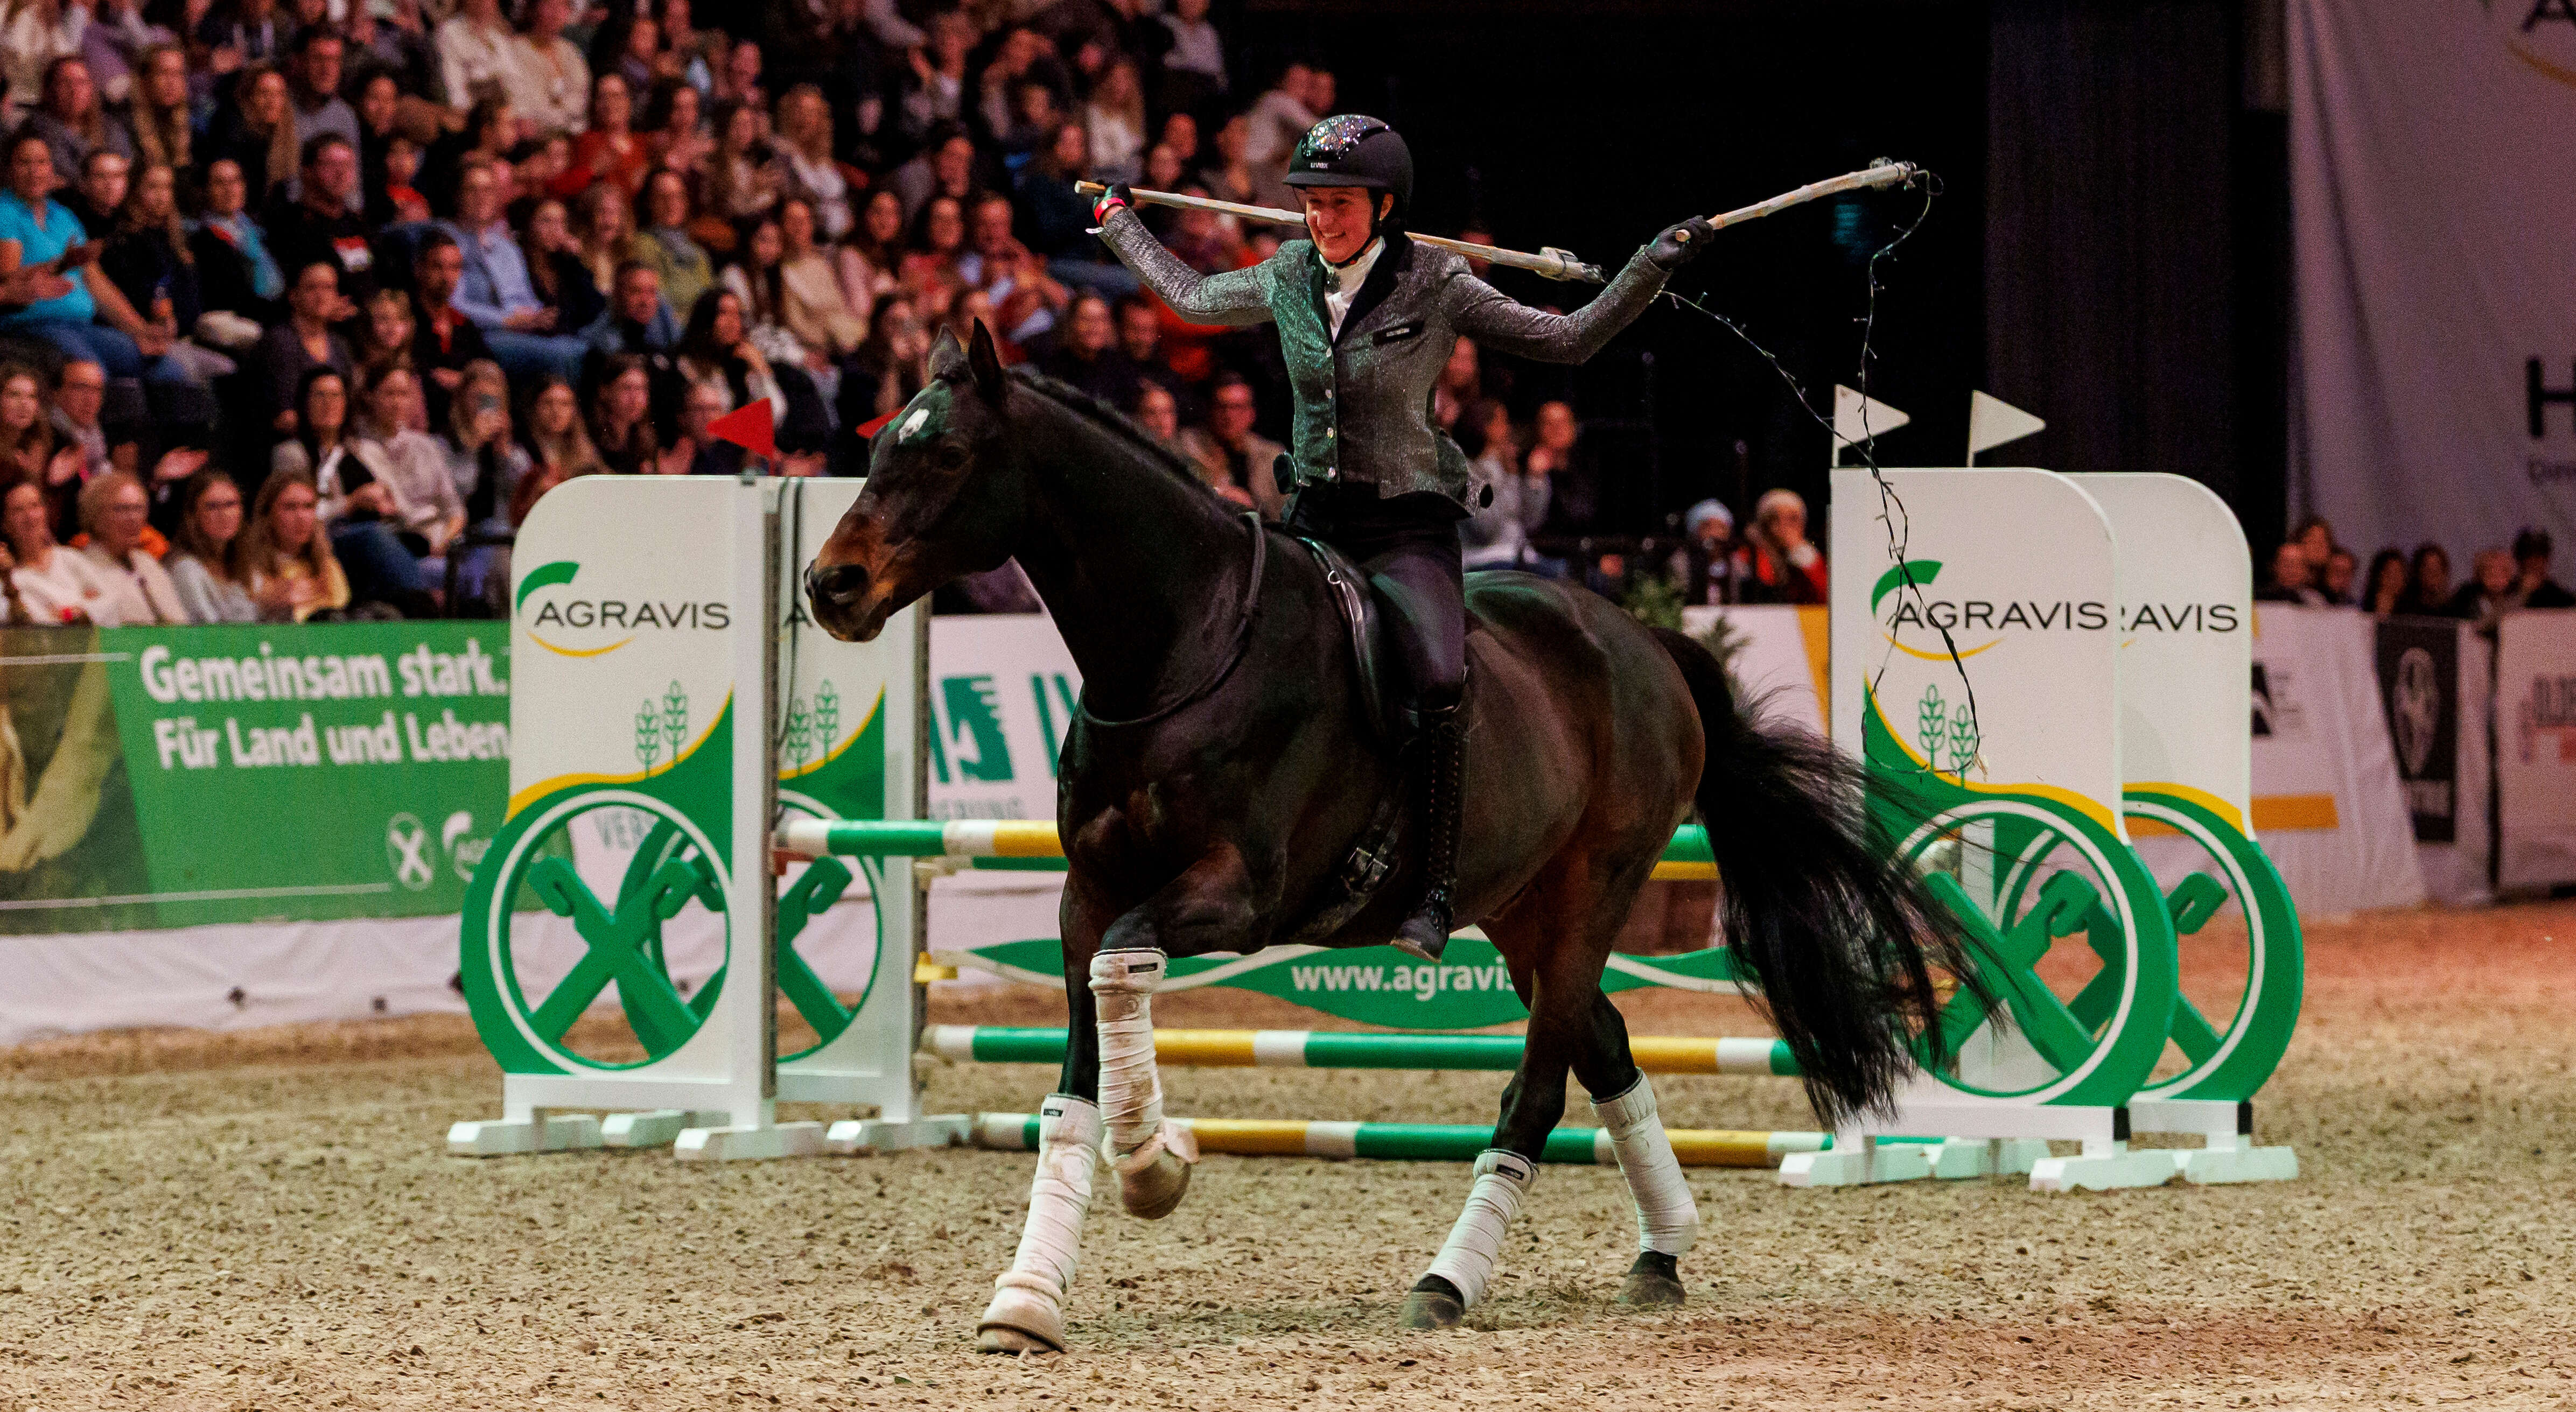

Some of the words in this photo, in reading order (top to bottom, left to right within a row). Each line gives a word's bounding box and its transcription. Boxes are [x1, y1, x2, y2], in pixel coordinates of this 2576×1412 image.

[533, 599, 730, 630] AGRAVIS
[1891, 600, 2108, 630] AGRAVIS
[2120, 603, 2238, 632] AVIS
[141, 642, 391, 703] Gemeinsam
[398, 637, 508, 697] stark.
[153, 716, 220, 769] Für
[226, 711, 321, 768] Land
[326, 709, 401, 765] und
[405, 708, 509, 763] Leben
